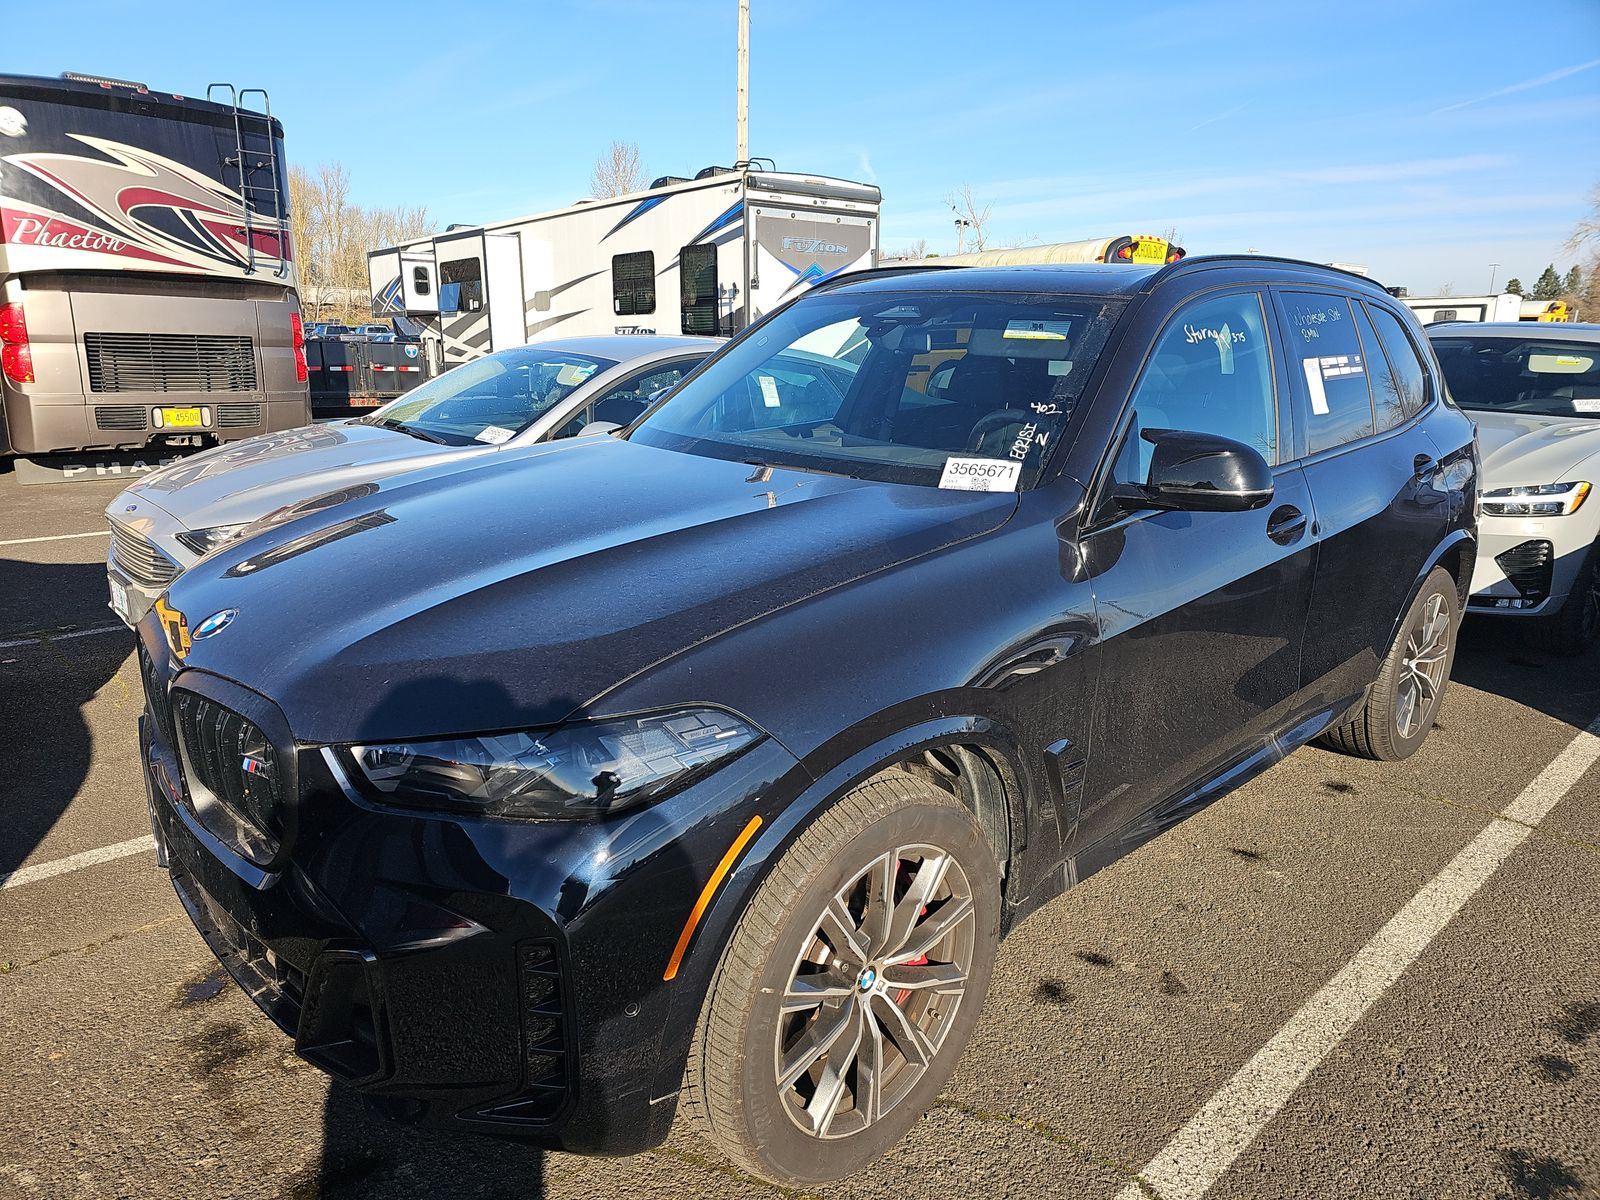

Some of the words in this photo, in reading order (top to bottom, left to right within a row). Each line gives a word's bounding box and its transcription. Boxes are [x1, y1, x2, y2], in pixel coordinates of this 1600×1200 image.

[10, 212, 127, 252] Phaeton
[1030, 401, 1063, 415] 402
[175, 411, 200, 423] 45500
[949, 462, 1015, 479] 3565671
